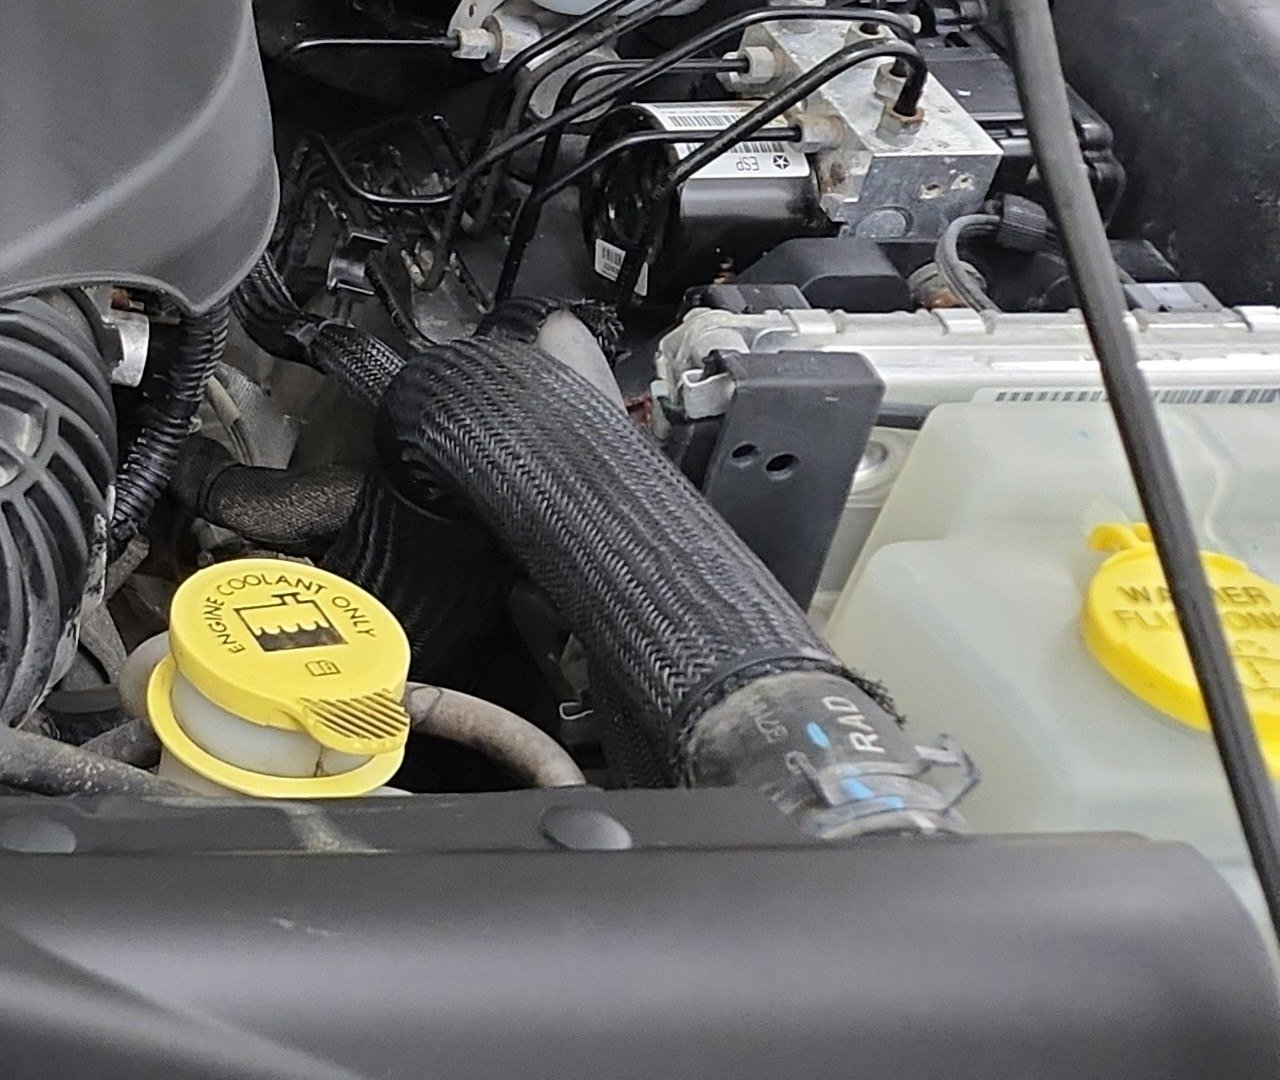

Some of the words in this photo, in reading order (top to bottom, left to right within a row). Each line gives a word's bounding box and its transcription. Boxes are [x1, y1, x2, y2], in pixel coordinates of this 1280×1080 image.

[735, 155, 761, 172] ESP
[217, 572, 328, 597] COOLANT
[202, 596, 246, 654] ENGINE
[331, 595, 378, 639] ONLY
[821, 695, 886, 753] RAD
